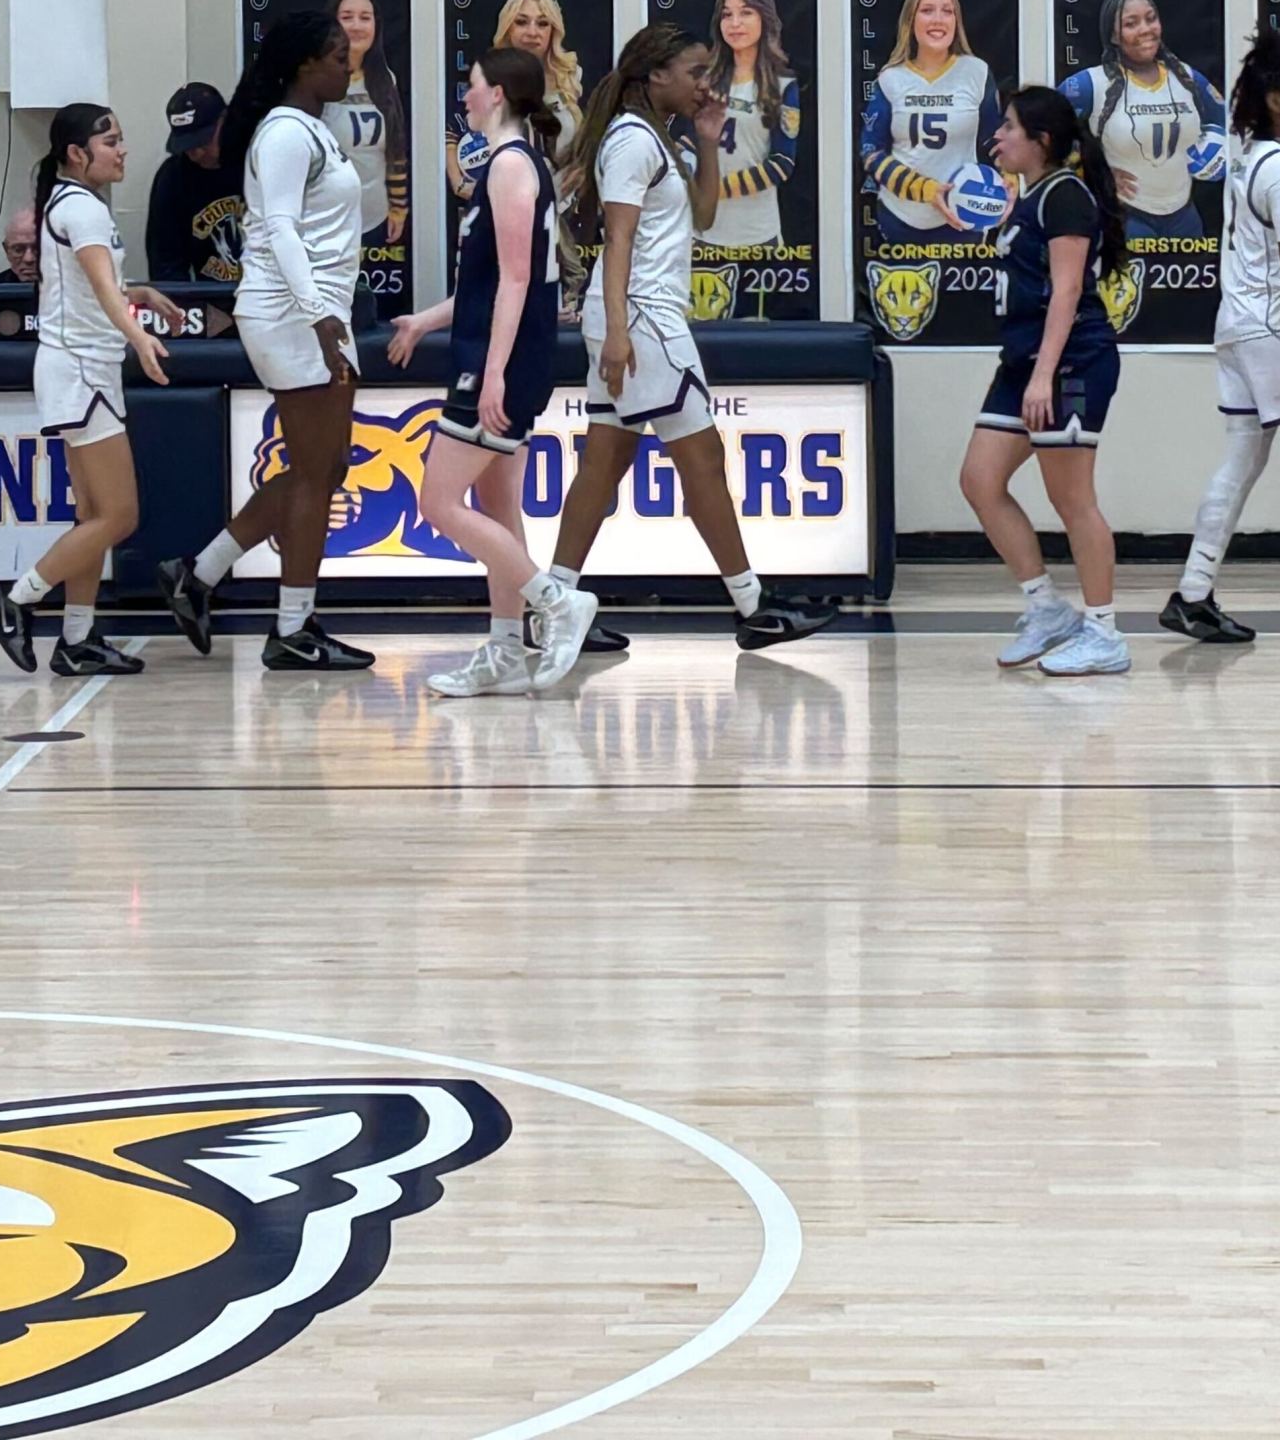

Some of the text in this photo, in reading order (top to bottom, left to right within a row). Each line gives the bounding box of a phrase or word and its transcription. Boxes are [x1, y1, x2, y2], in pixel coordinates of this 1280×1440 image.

[348, 110, 382, 148] 17
[909, 113, 948, 150] 15
[1152, 122, 1180, 159] 11
[879, 243, 999, 259] CORNERSTON
[744, 268, 810, 293] 2025
[945, 266, 995, 291] 202
[1150, 264, 1217, 288] 2025
